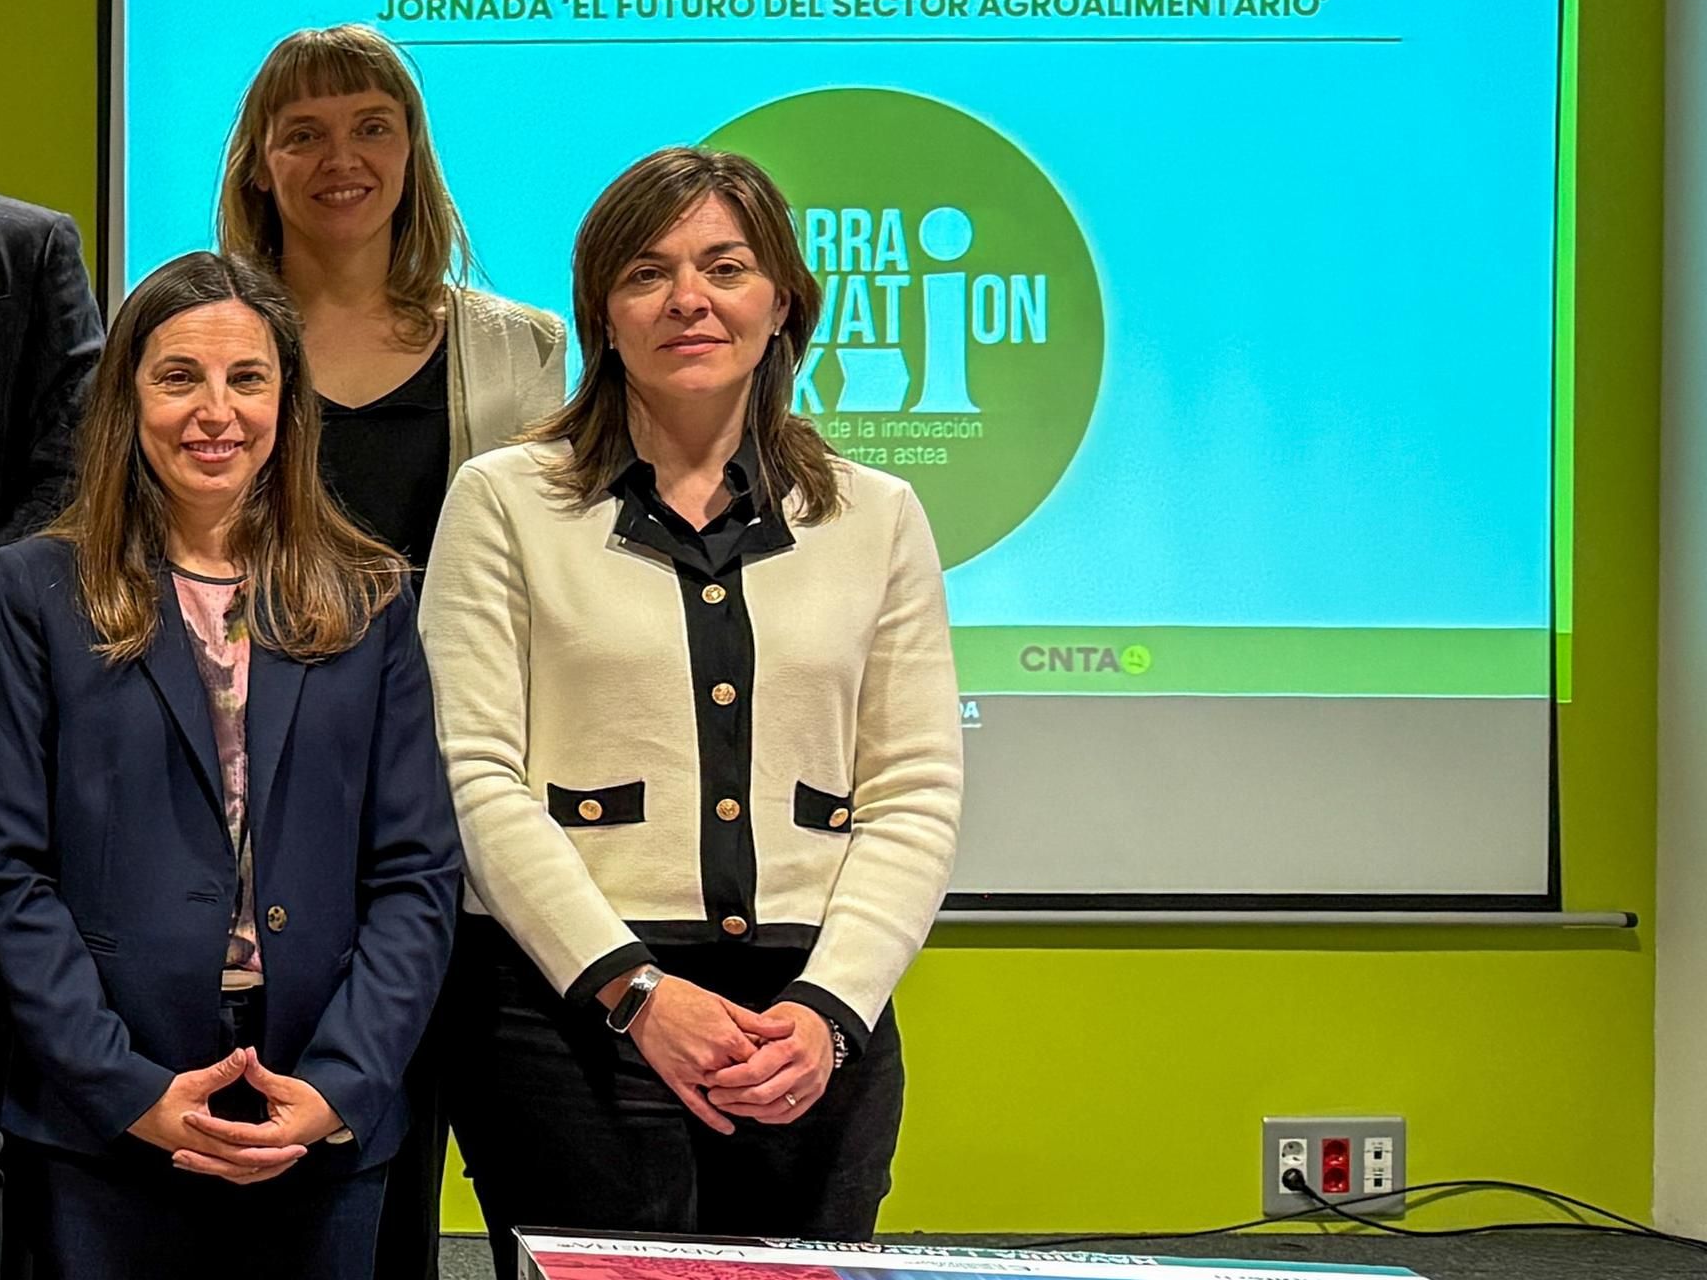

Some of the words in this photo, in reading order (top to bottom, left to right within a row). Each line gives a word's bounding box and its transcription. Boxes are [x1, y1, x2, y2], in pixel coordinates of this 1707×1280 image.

[827, 418, 852, 438] de
[858, 418, 876, 438] la
[881, 417, 983, 439] innovación
[893, 446, 948, 465] astea
[1020, 645, 1119, 672] CNTA
